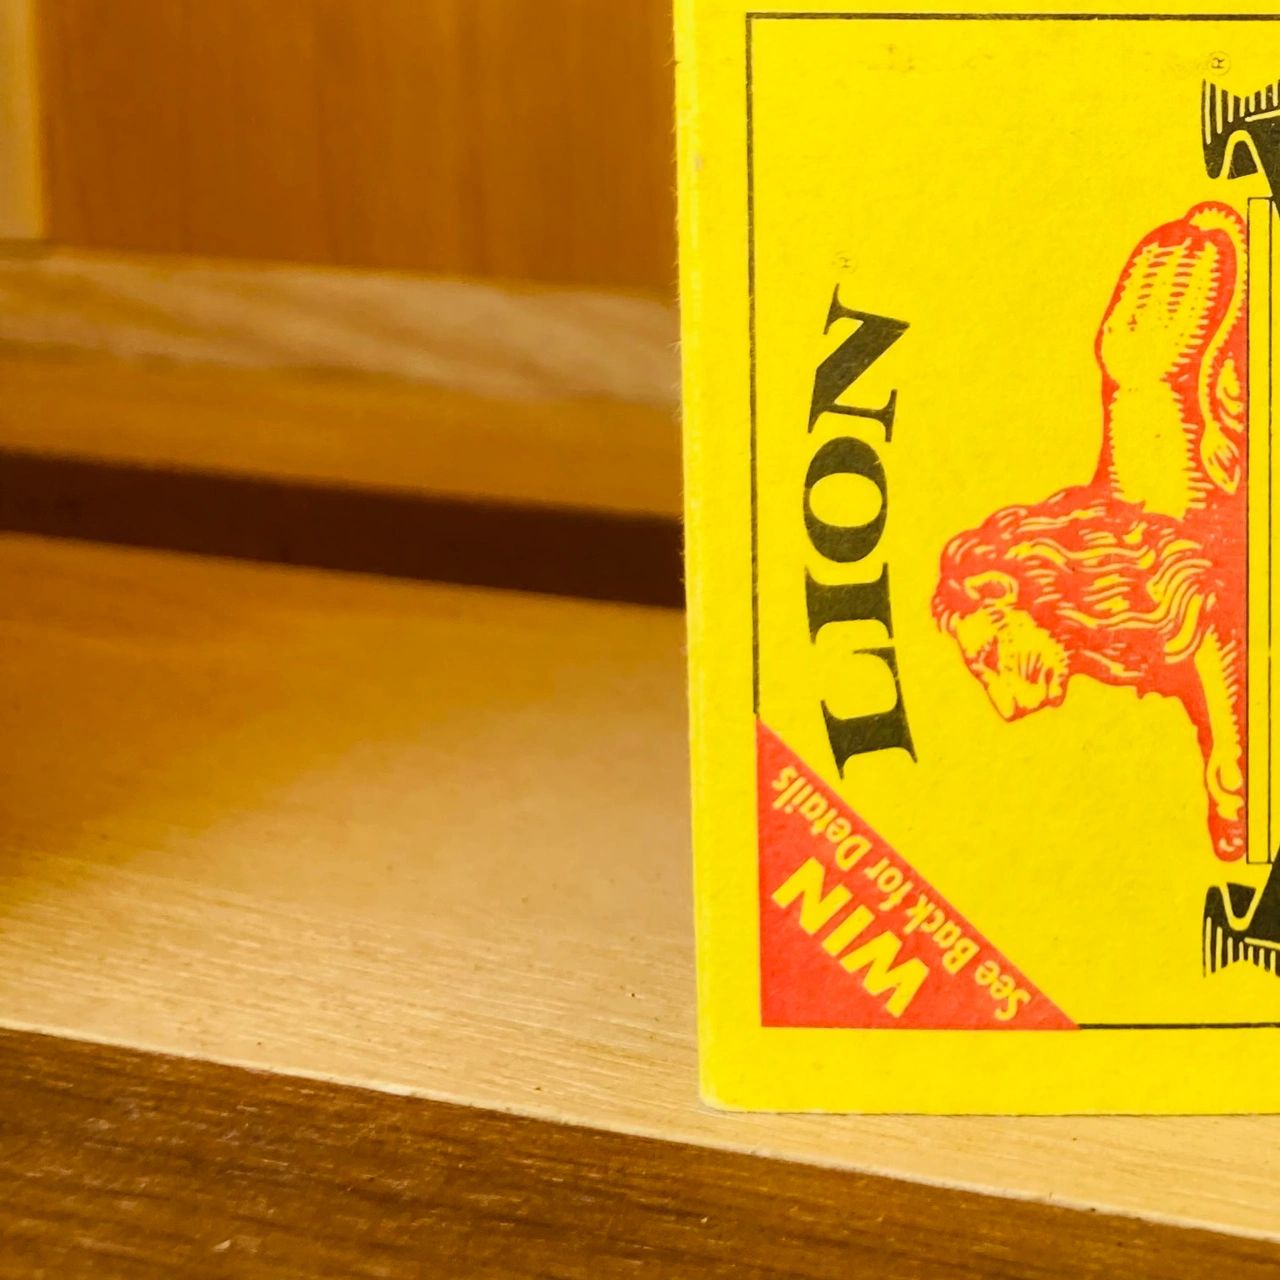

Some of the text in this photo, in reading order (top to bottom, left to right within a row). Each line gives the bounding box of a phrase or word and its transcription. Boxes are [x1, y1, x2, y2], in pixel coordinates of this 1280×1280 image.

[802, 282, 917, 780] LION
[770, 855, 930, 1018] WIN
[771, 765, 1032, 1021] See Back for Details
